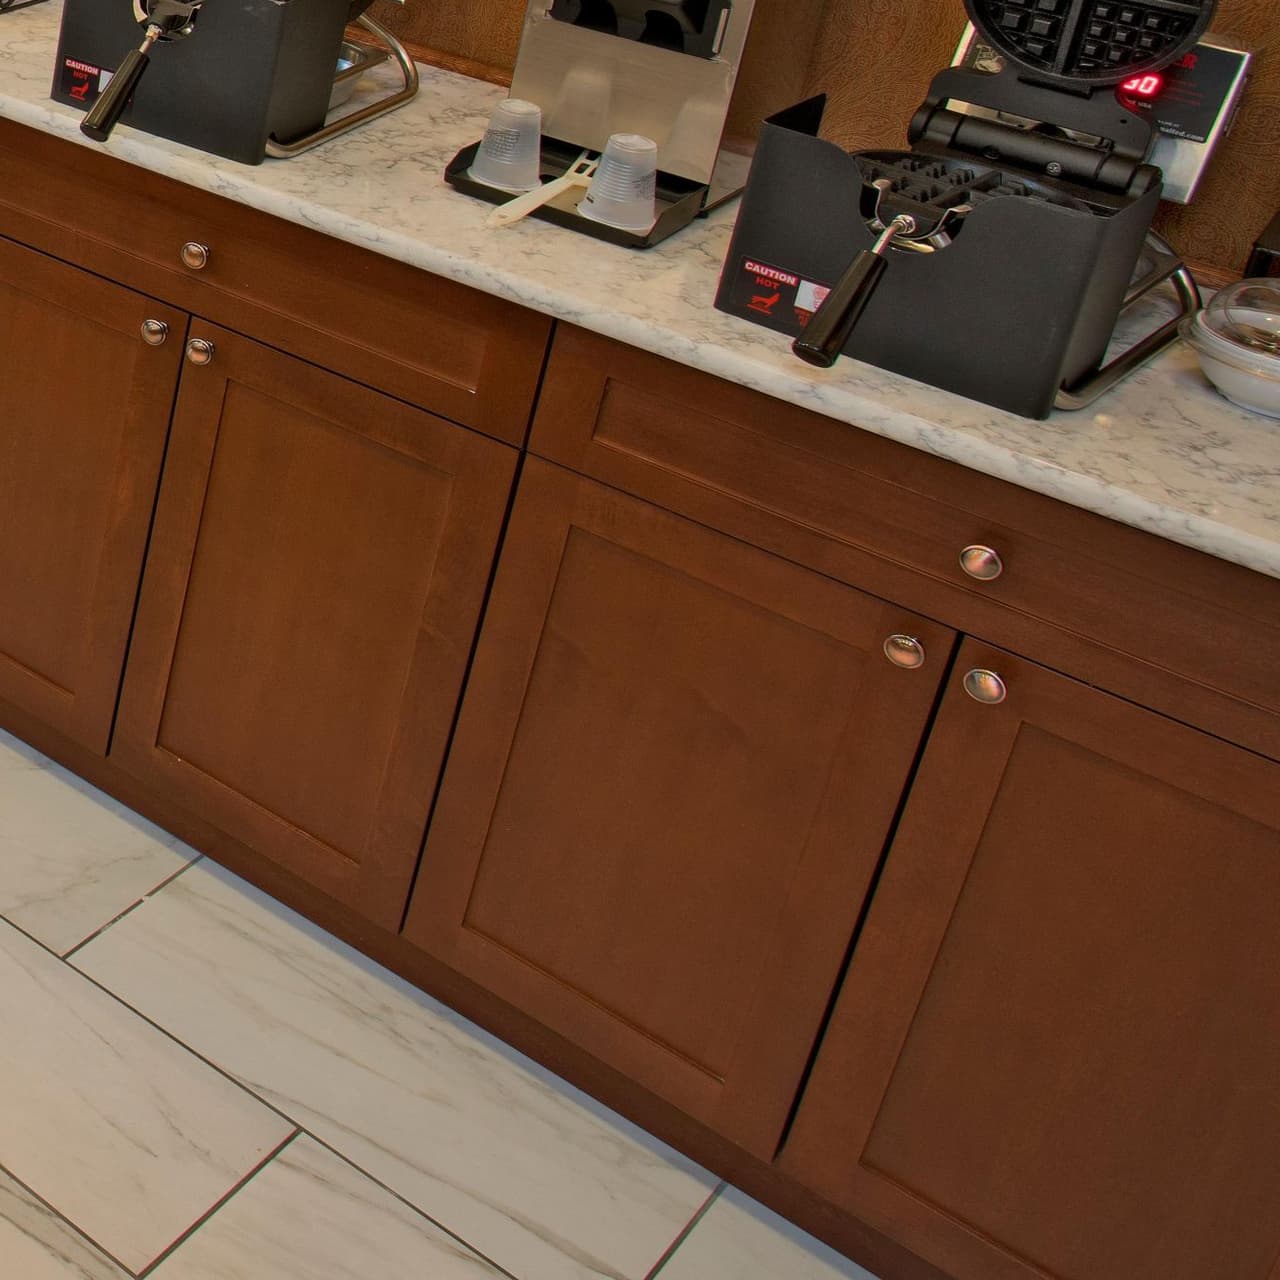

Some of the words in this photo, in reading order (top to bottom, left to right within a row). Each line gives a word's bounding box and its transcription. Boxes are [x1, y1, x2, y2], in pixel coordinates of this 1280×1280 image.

[66, 59, 99, 76] CAUTION
[73, 70, 88, 80] HOT
[744, 261, 796, 286] CAUTION
[755, 276, 780, 290] HOT
